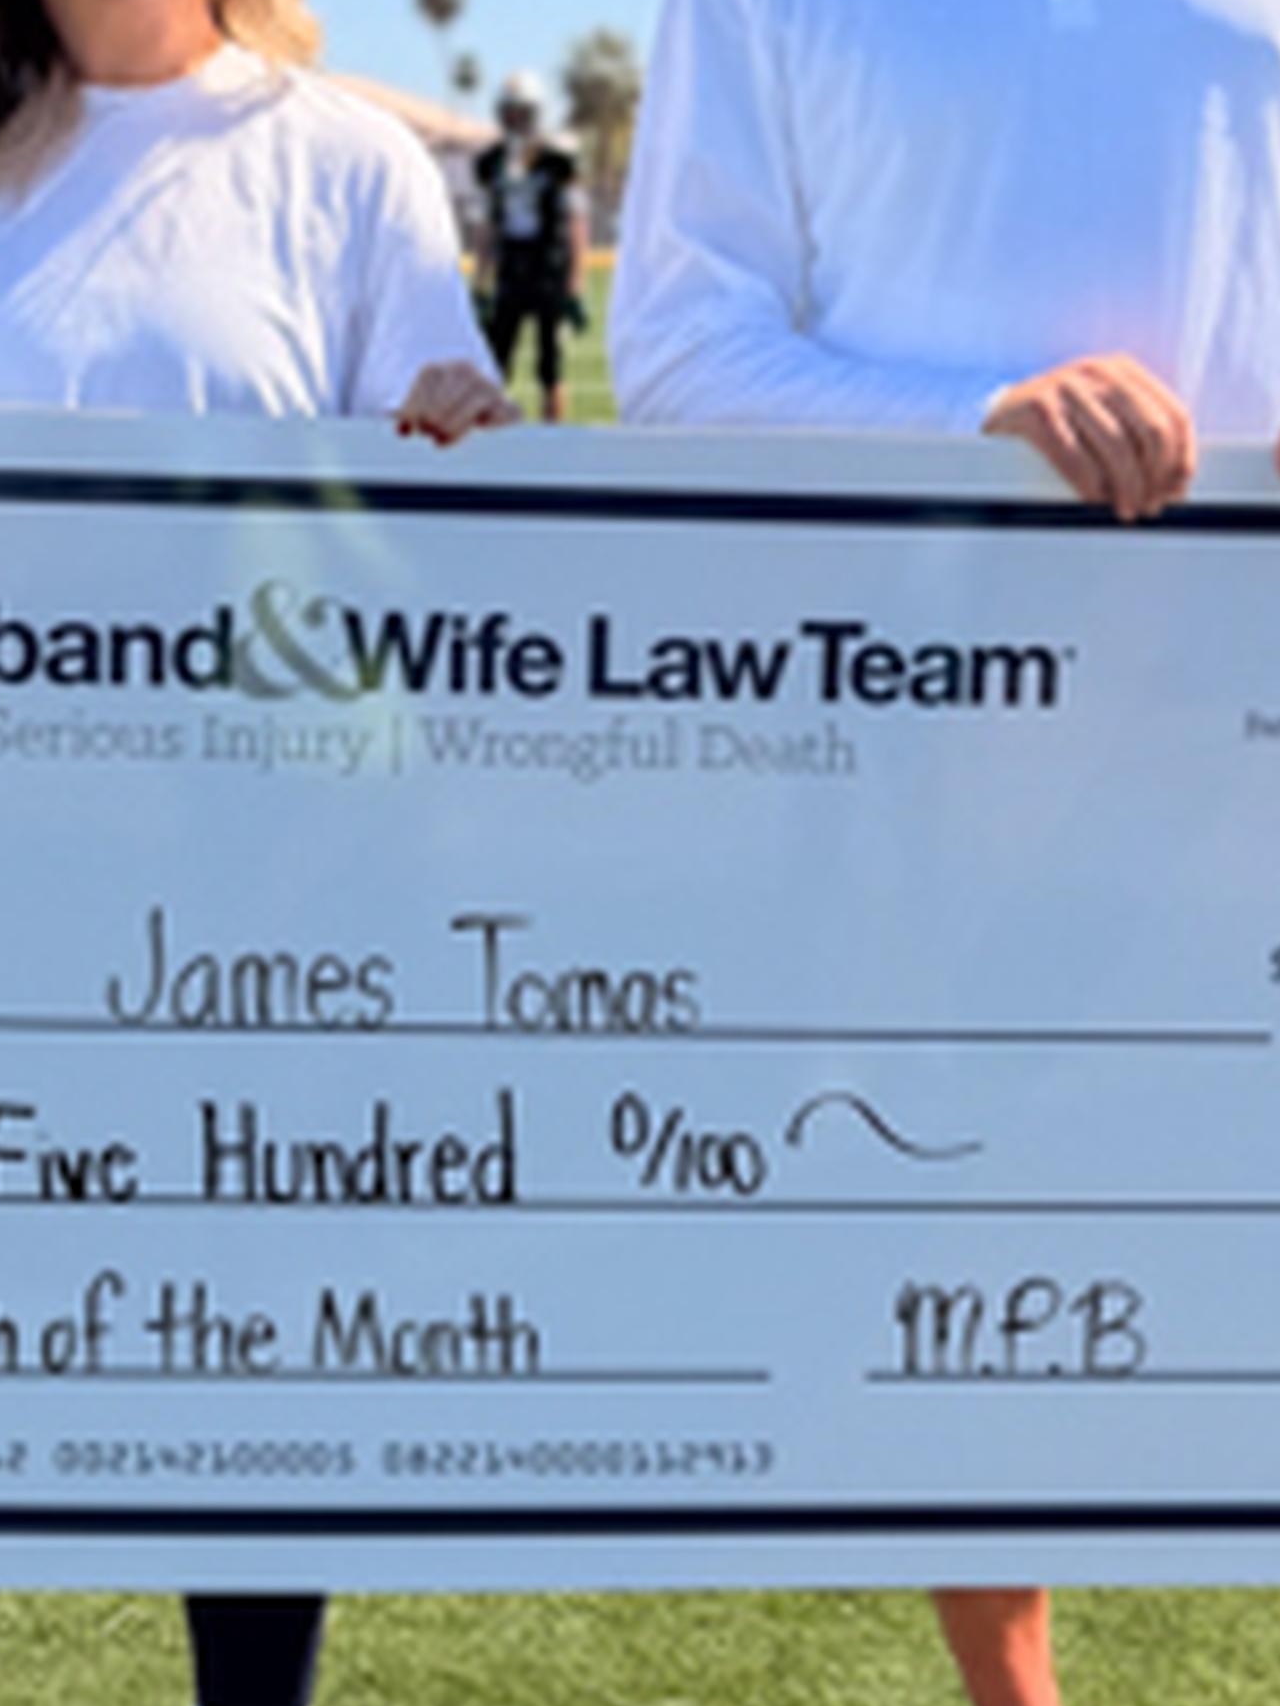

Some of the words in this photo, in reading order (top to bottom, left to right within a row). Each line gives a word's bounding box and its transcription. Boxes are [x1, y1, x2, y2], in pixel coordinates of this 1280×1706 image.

[232, 579, 365, 700] &
[342, 610, 563, 693] Wife
[588, 615, 790, 701] Law
[800, 620, 1059, 708] Team
[202, 713, 371, 775] Injury
[422, 718, 679, 780] Wrongful
[699, 726, 858, 775] Death
[107, 906, 395, 1031] James
[451, 914, 701, 1033] Tomas
[201, 1089, 515, 1203] Hundred
[40, 1270, 124, 1374] of
[143, 1280, 276, 1373] the
[312, 1289, 540, 1376] Month
